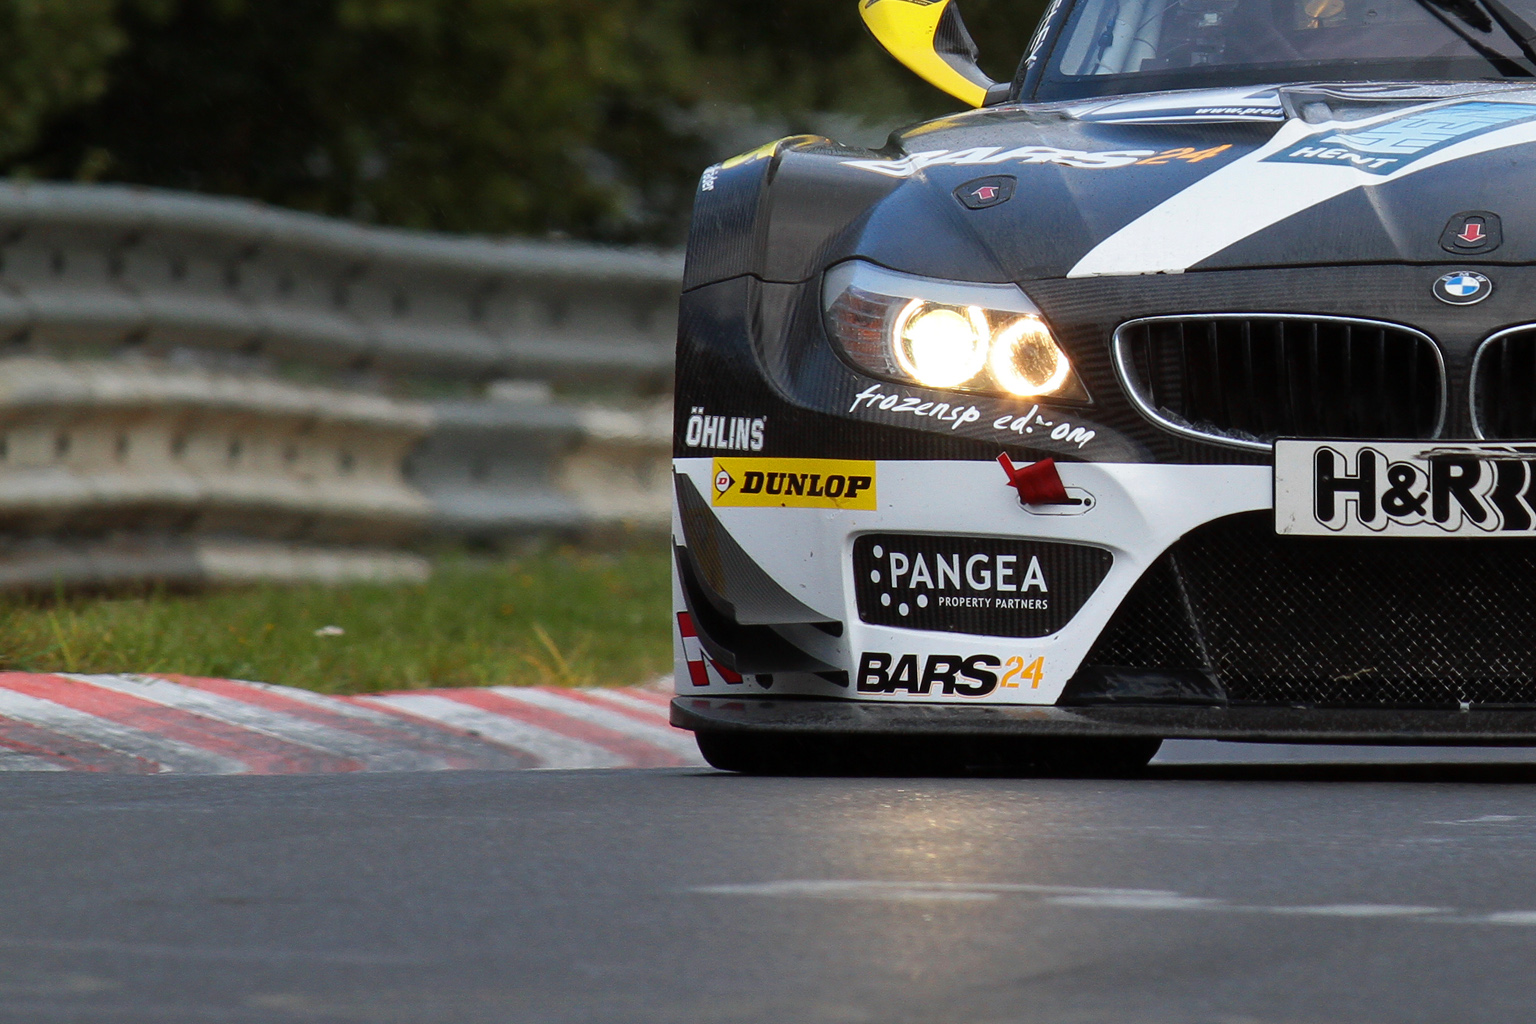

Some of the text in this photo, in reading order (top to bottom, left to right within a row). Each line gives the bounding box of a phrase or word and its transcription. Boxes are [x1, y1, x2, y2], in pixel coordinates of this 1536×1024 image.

[1288, 146, 1398, 169] HENT
[849, 384, 981, 430] frozensp
[686, 407, 765, 452] ÖHLINS
[740, 471, 872, 499] DUNLOP
[890, 552, 1049, 593] PANGEA
[938, 595, 1049, 611] PROPERTY PARTNERS
